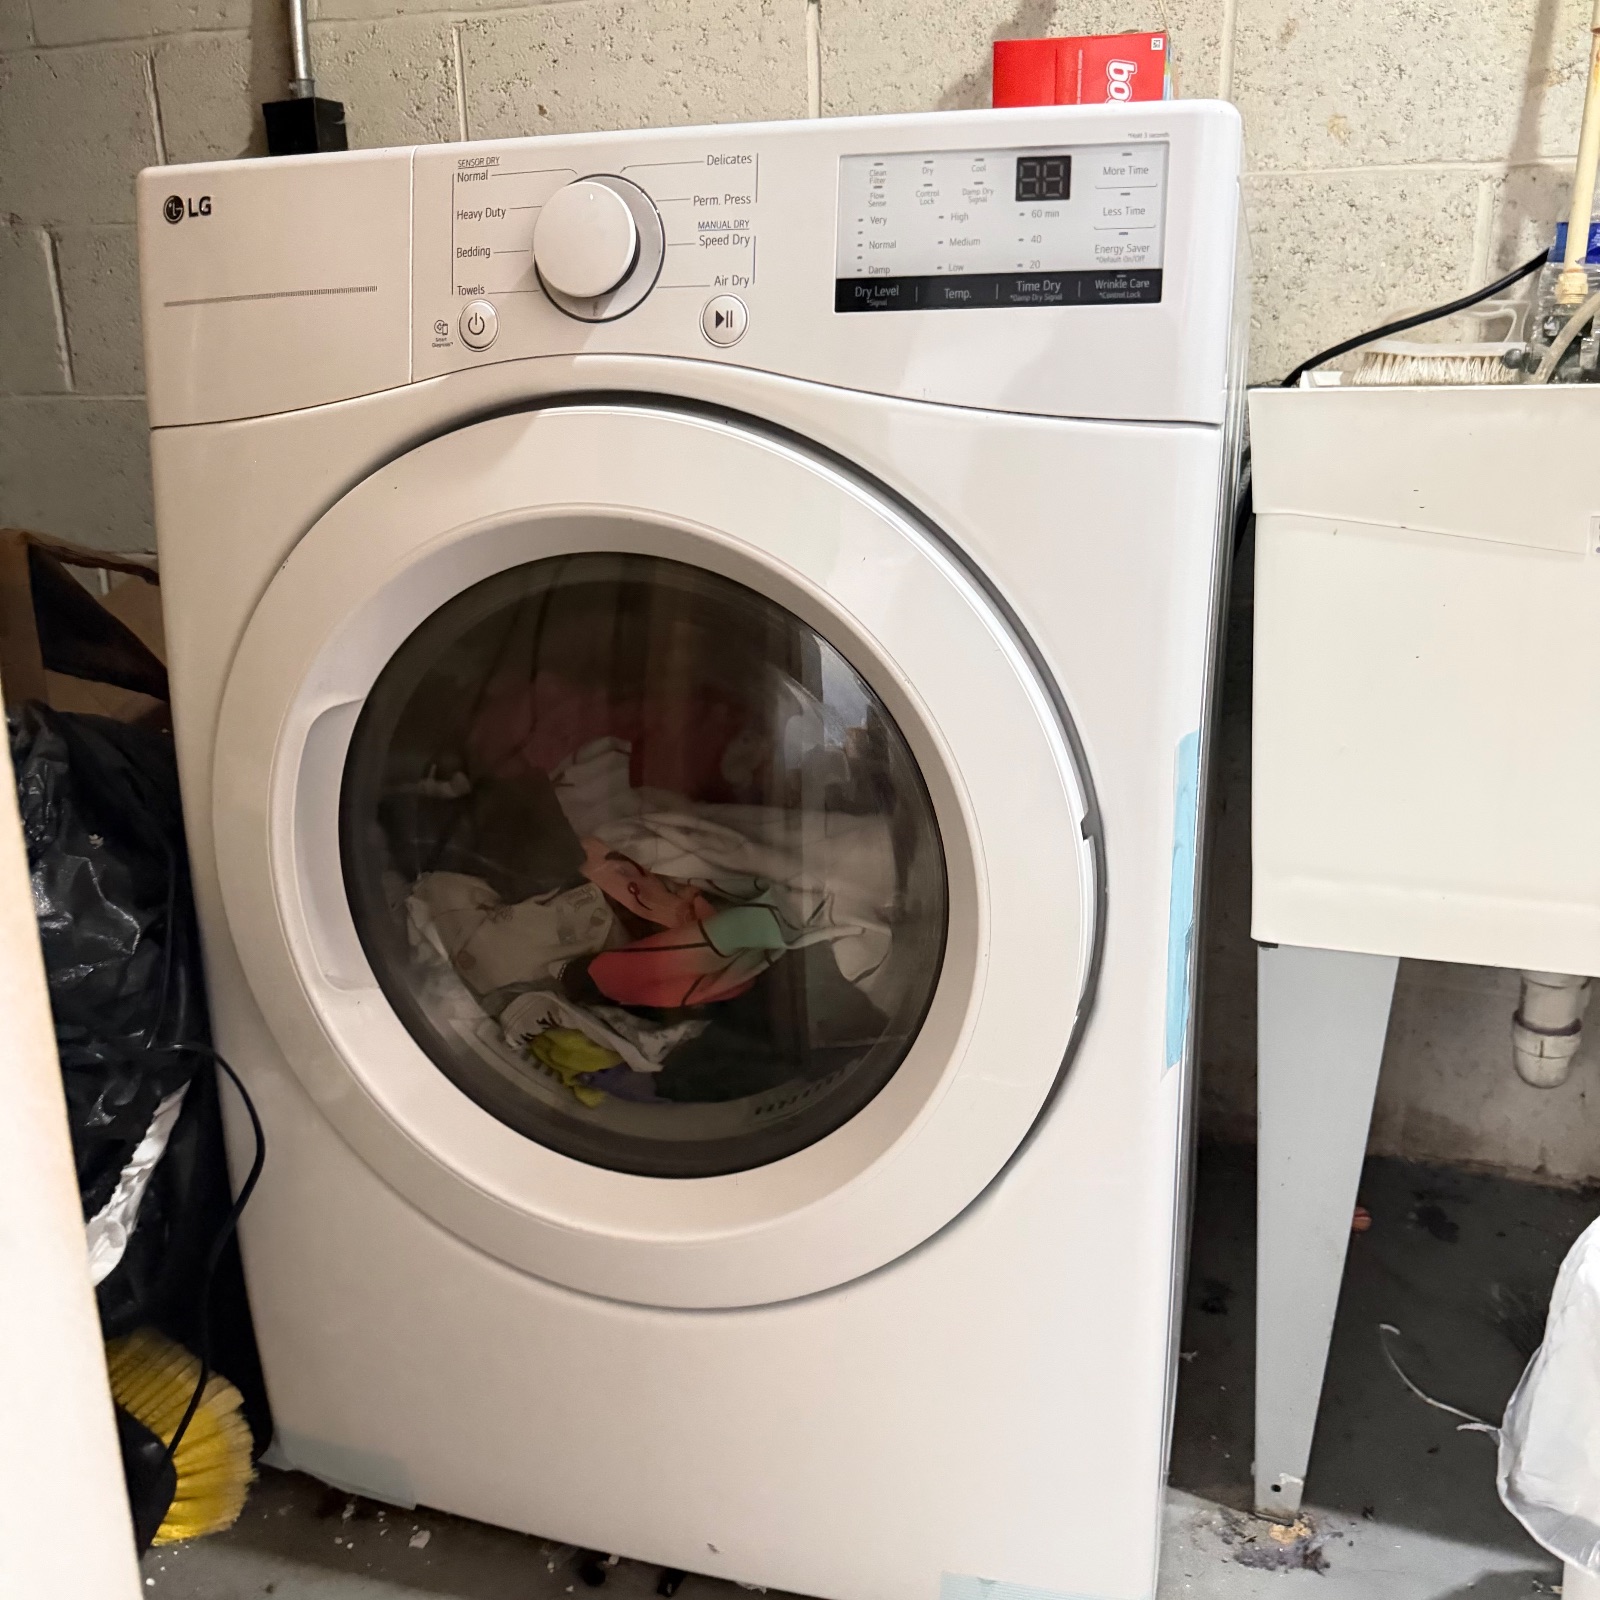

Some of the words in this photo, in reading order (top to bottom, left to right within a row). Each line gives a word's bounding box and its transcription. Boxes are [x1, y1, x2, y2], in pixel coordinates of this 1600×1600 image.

[457, 158, 484, 168] SENSOR
[486, 156, 500, 165] DRY
[706, 153, 753, 166] Delicates
[922, 167, 934, 176] Dry
[972, 164, 986, 173] Cool
[1102, 166, 1126, 176] More
[1128, 166, 1150, 175] Time
[457, 169, 489, 183] Normal
[916, 190, 940, 198] Control
[693, 195, 721, 207] Perm.
[724, 193, 752, 205] Press
[920, 198, 935, 206] Lock
[188, 196, 212, 218] LG
[1102, 208, 1122, 217] Less
[1126, 206, 1146, 216] Time
[456, 209, 483, 222] Heavy
[485, 207, 507, 219] Duty
[950, 213, 969, 223] High
[1032, 209, 1042, 218] 60
[697, 220, 731, 229] MANUAL
[734, 219, 750, 229] DRY
[870, 216, 888, 226] Very
[699, 234, 730, 249] Speed
[732, 233, 751, 248] Dry
[949, 237, 980, 247] Medium
[1030, 234, 1042, 244] 40
[868, 240, 896, 250] Normal
[1094, 244, 1124, 256] Energy
[1126, 244, 1150, 253] Saver
[456, 246, 491, 259] Bedding
[948, 263, 964, 272] Low
[1030, 260, 1040, 269] 20
[868, 266, 890, 276] Damp
[714, 275, 729, 286] Air
[732, 274, 750, 289] Dry
[1016, 280, 1040, 292] Time
[1043, 280, 1061, 294] Dry
[1094, 279, 1128, 290] Wrinkle
[1129, 278, 1150, 288] Care
[456, 284, 486, 296] Towels
[854, 286, 872, 298] Dry
[874, 285, 900, 297] Level
[944, 288, 972, 301] Temp.
